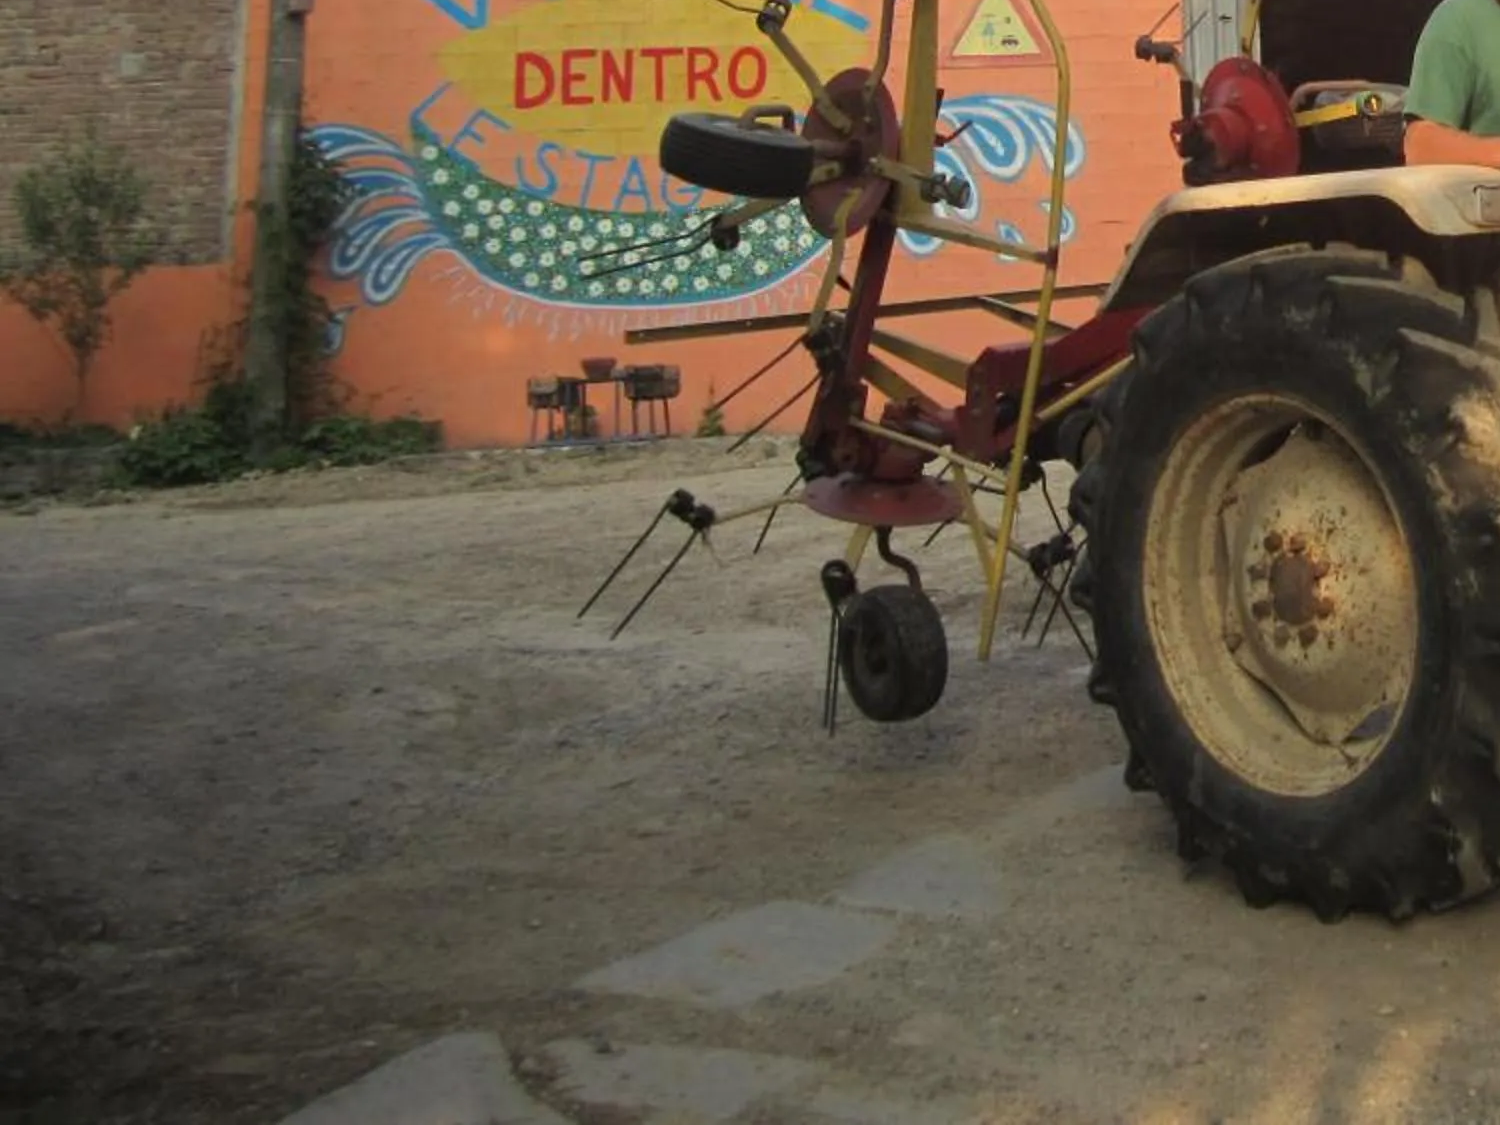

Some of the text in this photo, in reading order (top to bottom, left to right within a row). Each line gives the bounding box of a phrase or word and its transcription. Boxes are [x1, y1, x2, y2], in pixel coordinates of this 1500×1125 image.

[513, 46, 768, 109] DENTRO
[410, 81, 704, 214] LE STAG
